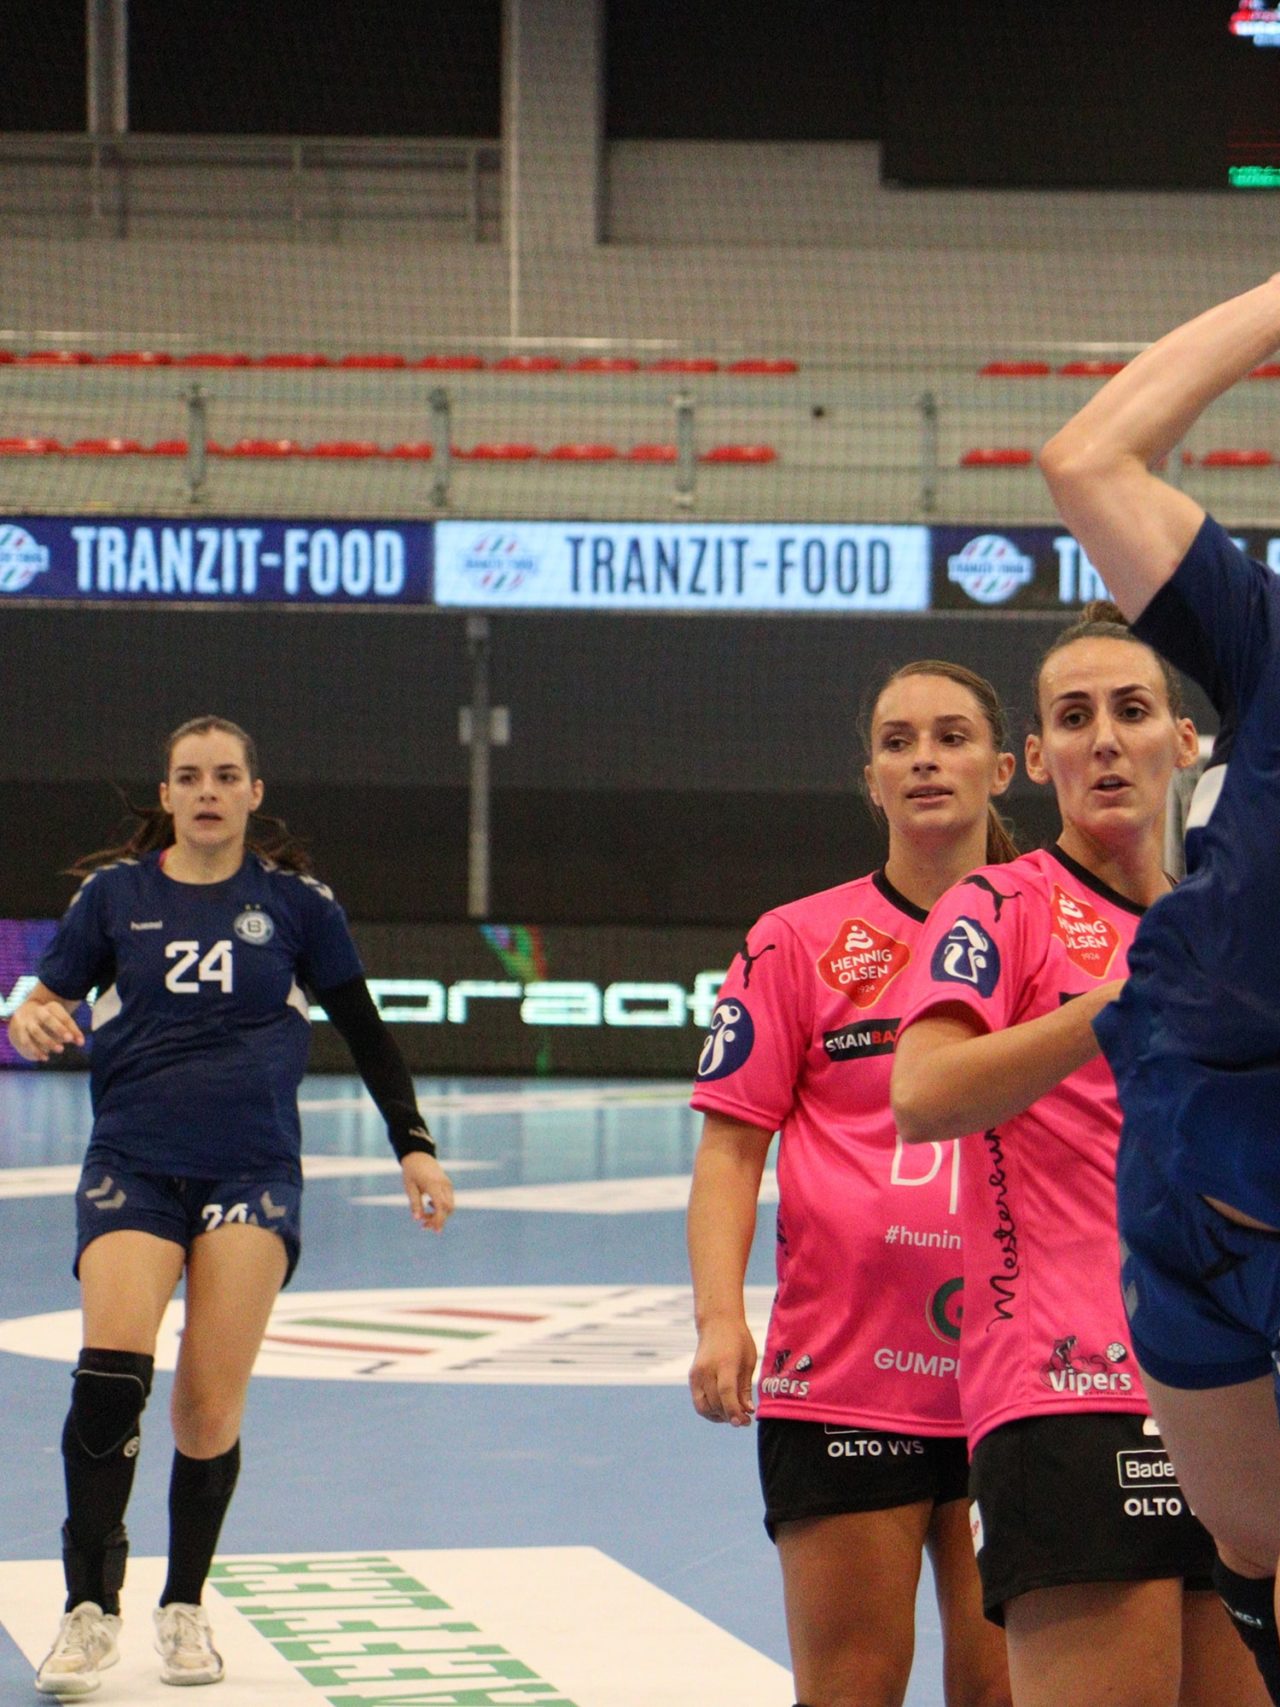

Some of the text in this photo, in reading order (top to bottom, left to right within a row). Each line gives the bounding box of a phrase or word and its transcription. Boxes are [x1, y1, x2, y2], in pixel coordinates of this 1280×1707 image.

[71, 526, 405, 596] TRANZIT-FOOD
[566, 535, 892, 596] TRANZIT-FOOD
[164, 939, 233, 993] 24
[830, 949, 893, 973] HENNIG
[838, 965, 888, 985] OLSEN
[885, 1225, 961, 1250] #hunin
[874, 1348, 960, 1379] GUMP
[1049, 1369, 1132, 1396] Vipers
[828, 1440, 924, 1457] OLTO VVS
[1125, 1460, 1175, 1478] Bade
[1124, 1498, 1182, 1516] OLTO
